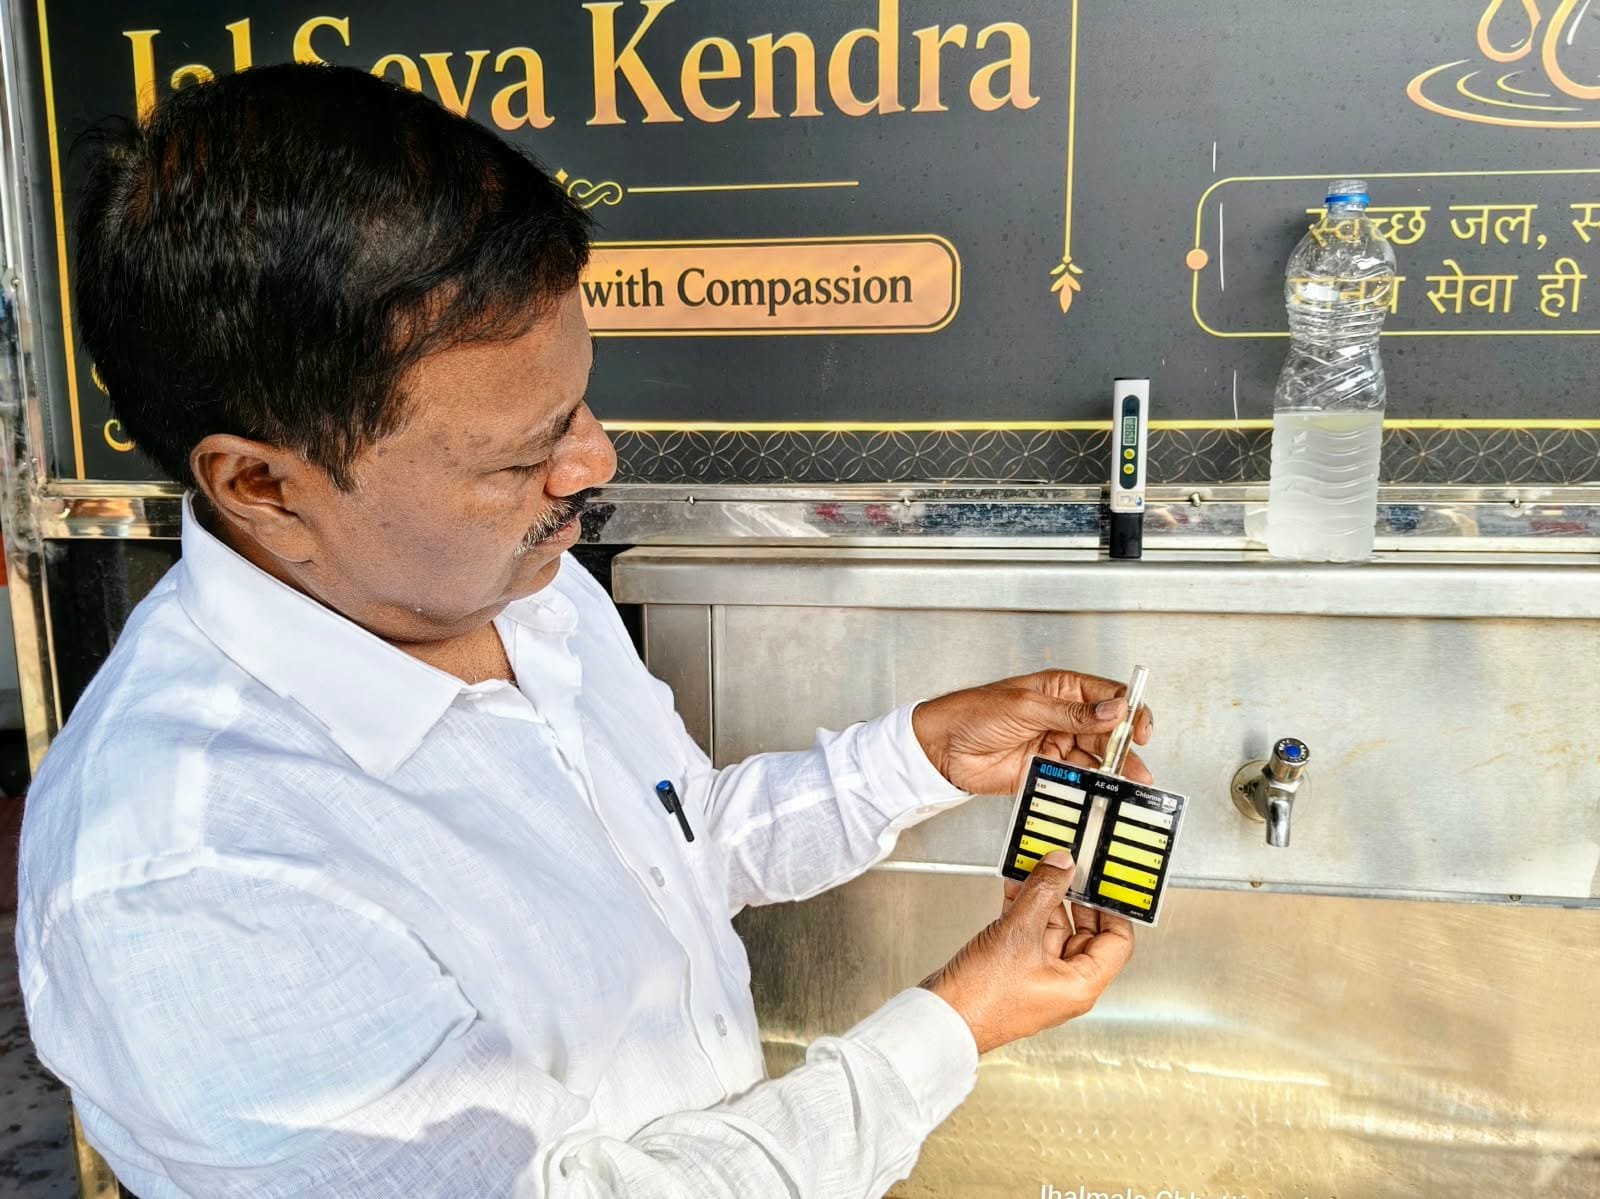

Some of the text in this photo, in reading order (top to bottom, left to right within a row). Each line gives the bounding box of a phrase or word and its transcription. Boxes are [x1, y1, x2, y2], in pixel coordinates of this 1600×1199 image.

[581, 0, 1041, 126] Kendra
[1449, 204, 1547, 250] जल,
[581, 264, 914, 317] with Compassion
[1425, 258, 1519, 314] सेवा
[1536, 257, 1588, 317] ही
